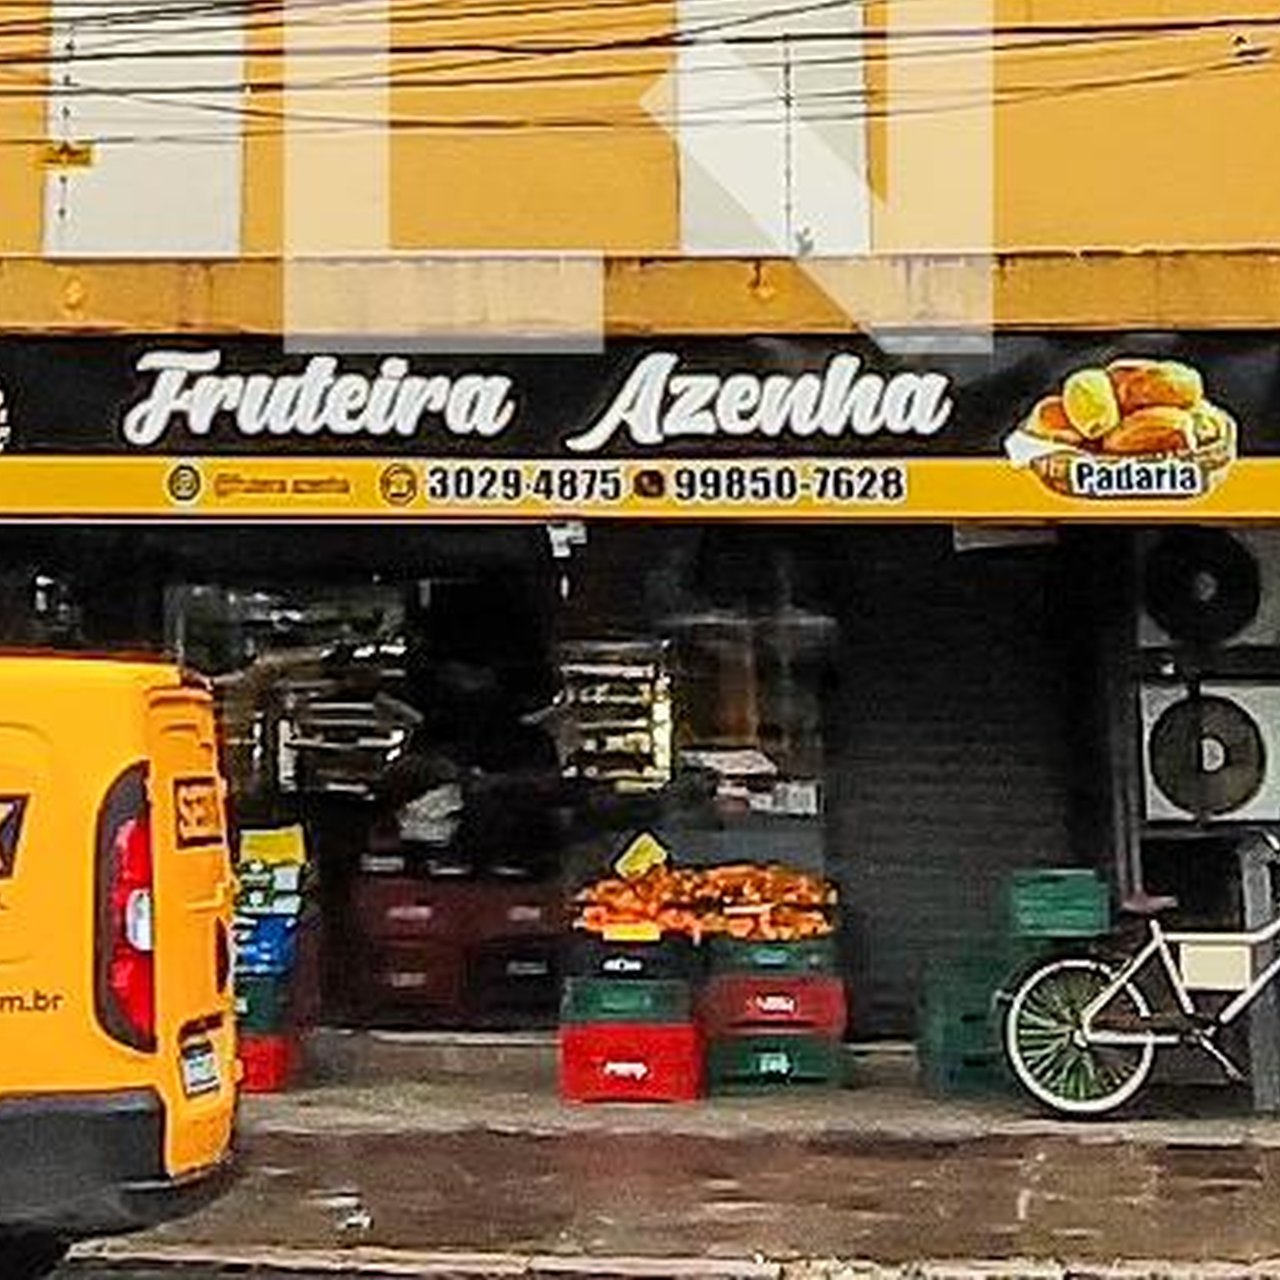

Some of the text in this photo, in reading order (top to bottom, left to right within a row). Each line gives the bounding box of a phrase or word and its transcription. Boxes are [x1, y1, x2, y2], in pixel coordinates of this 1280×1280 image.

[122, 349, 954, 452] Fruteira Azenha
[674, 467, 906, 502] 99850-7628
[1076, 462, 1198, 492] Padaria
